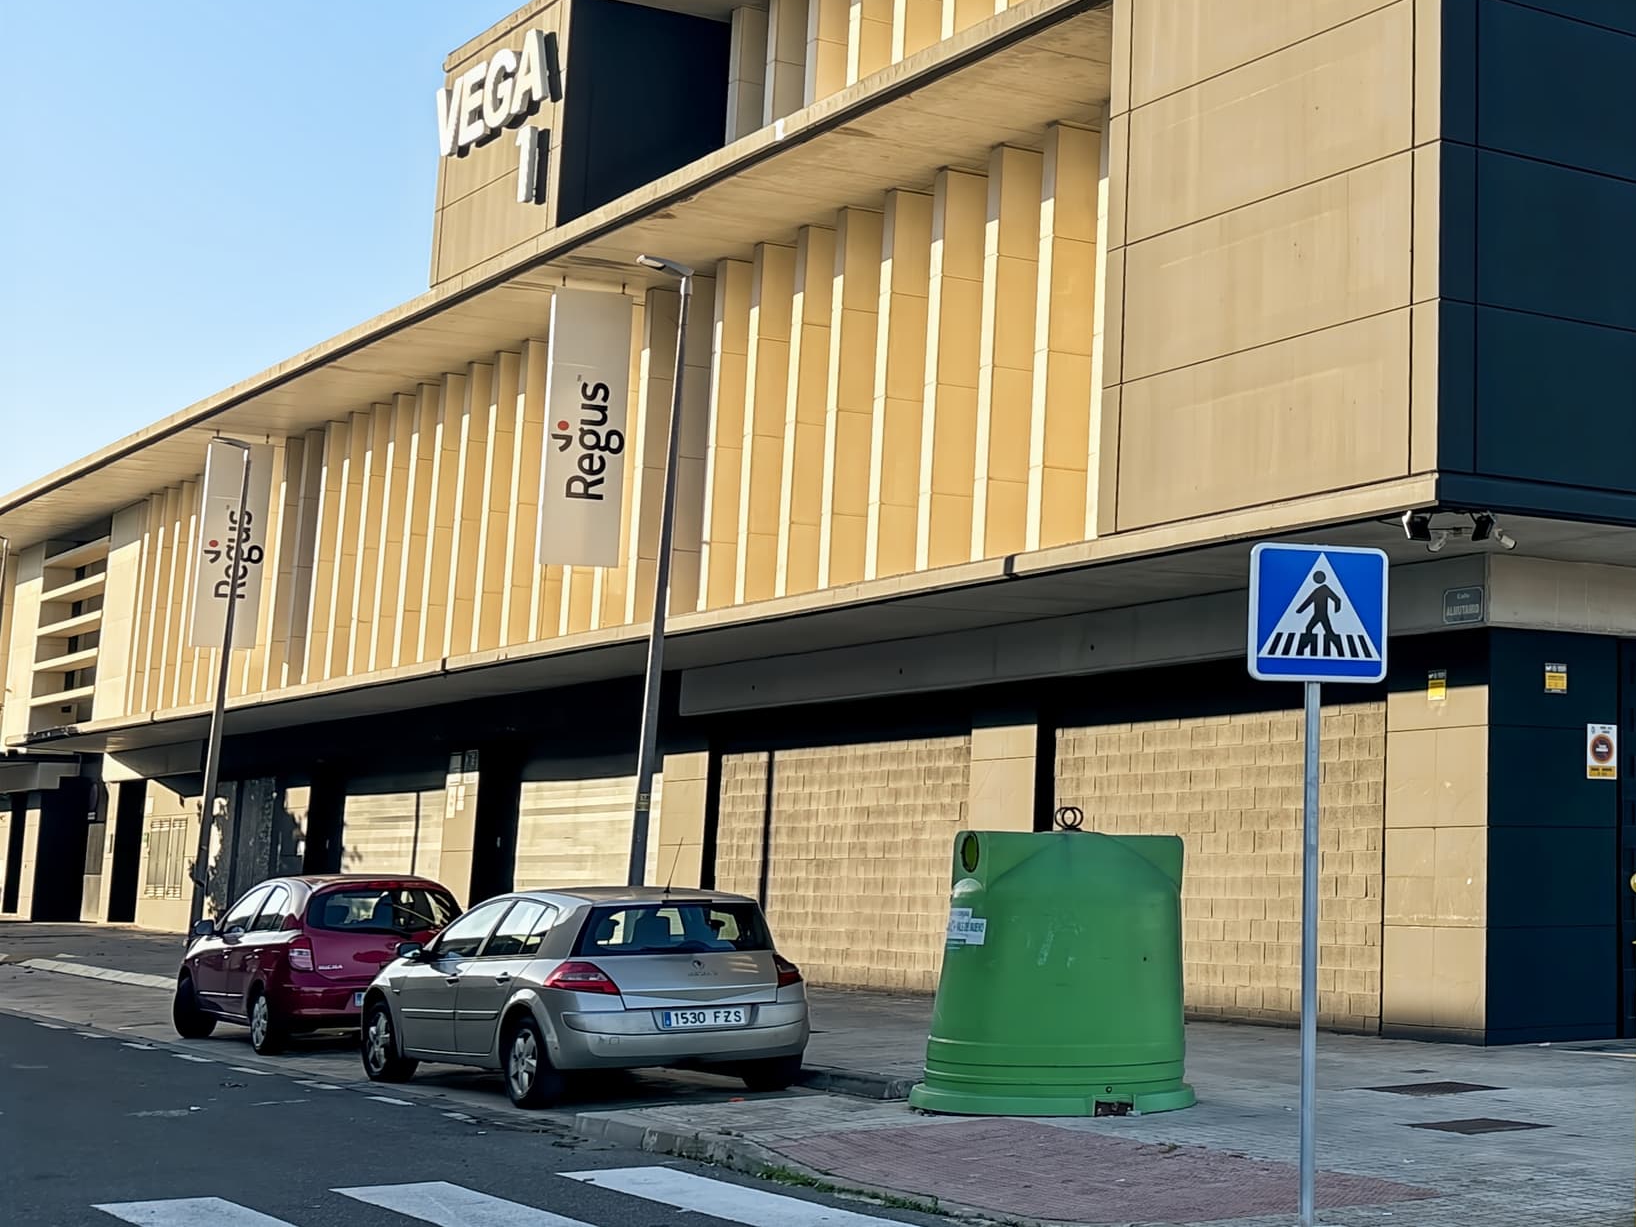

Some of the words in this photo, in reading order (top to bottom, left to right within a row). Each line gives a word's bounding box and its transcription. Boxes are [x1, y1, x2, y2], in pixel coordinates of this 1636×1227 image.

[435, 27, 550, 158] VEGA
[514, 125, 539, 204] 1
[565, 381, 625, 501] Regus
[673, 1011, 706, 1025] 1530
[713, 1010, 742, 1024] FZS
